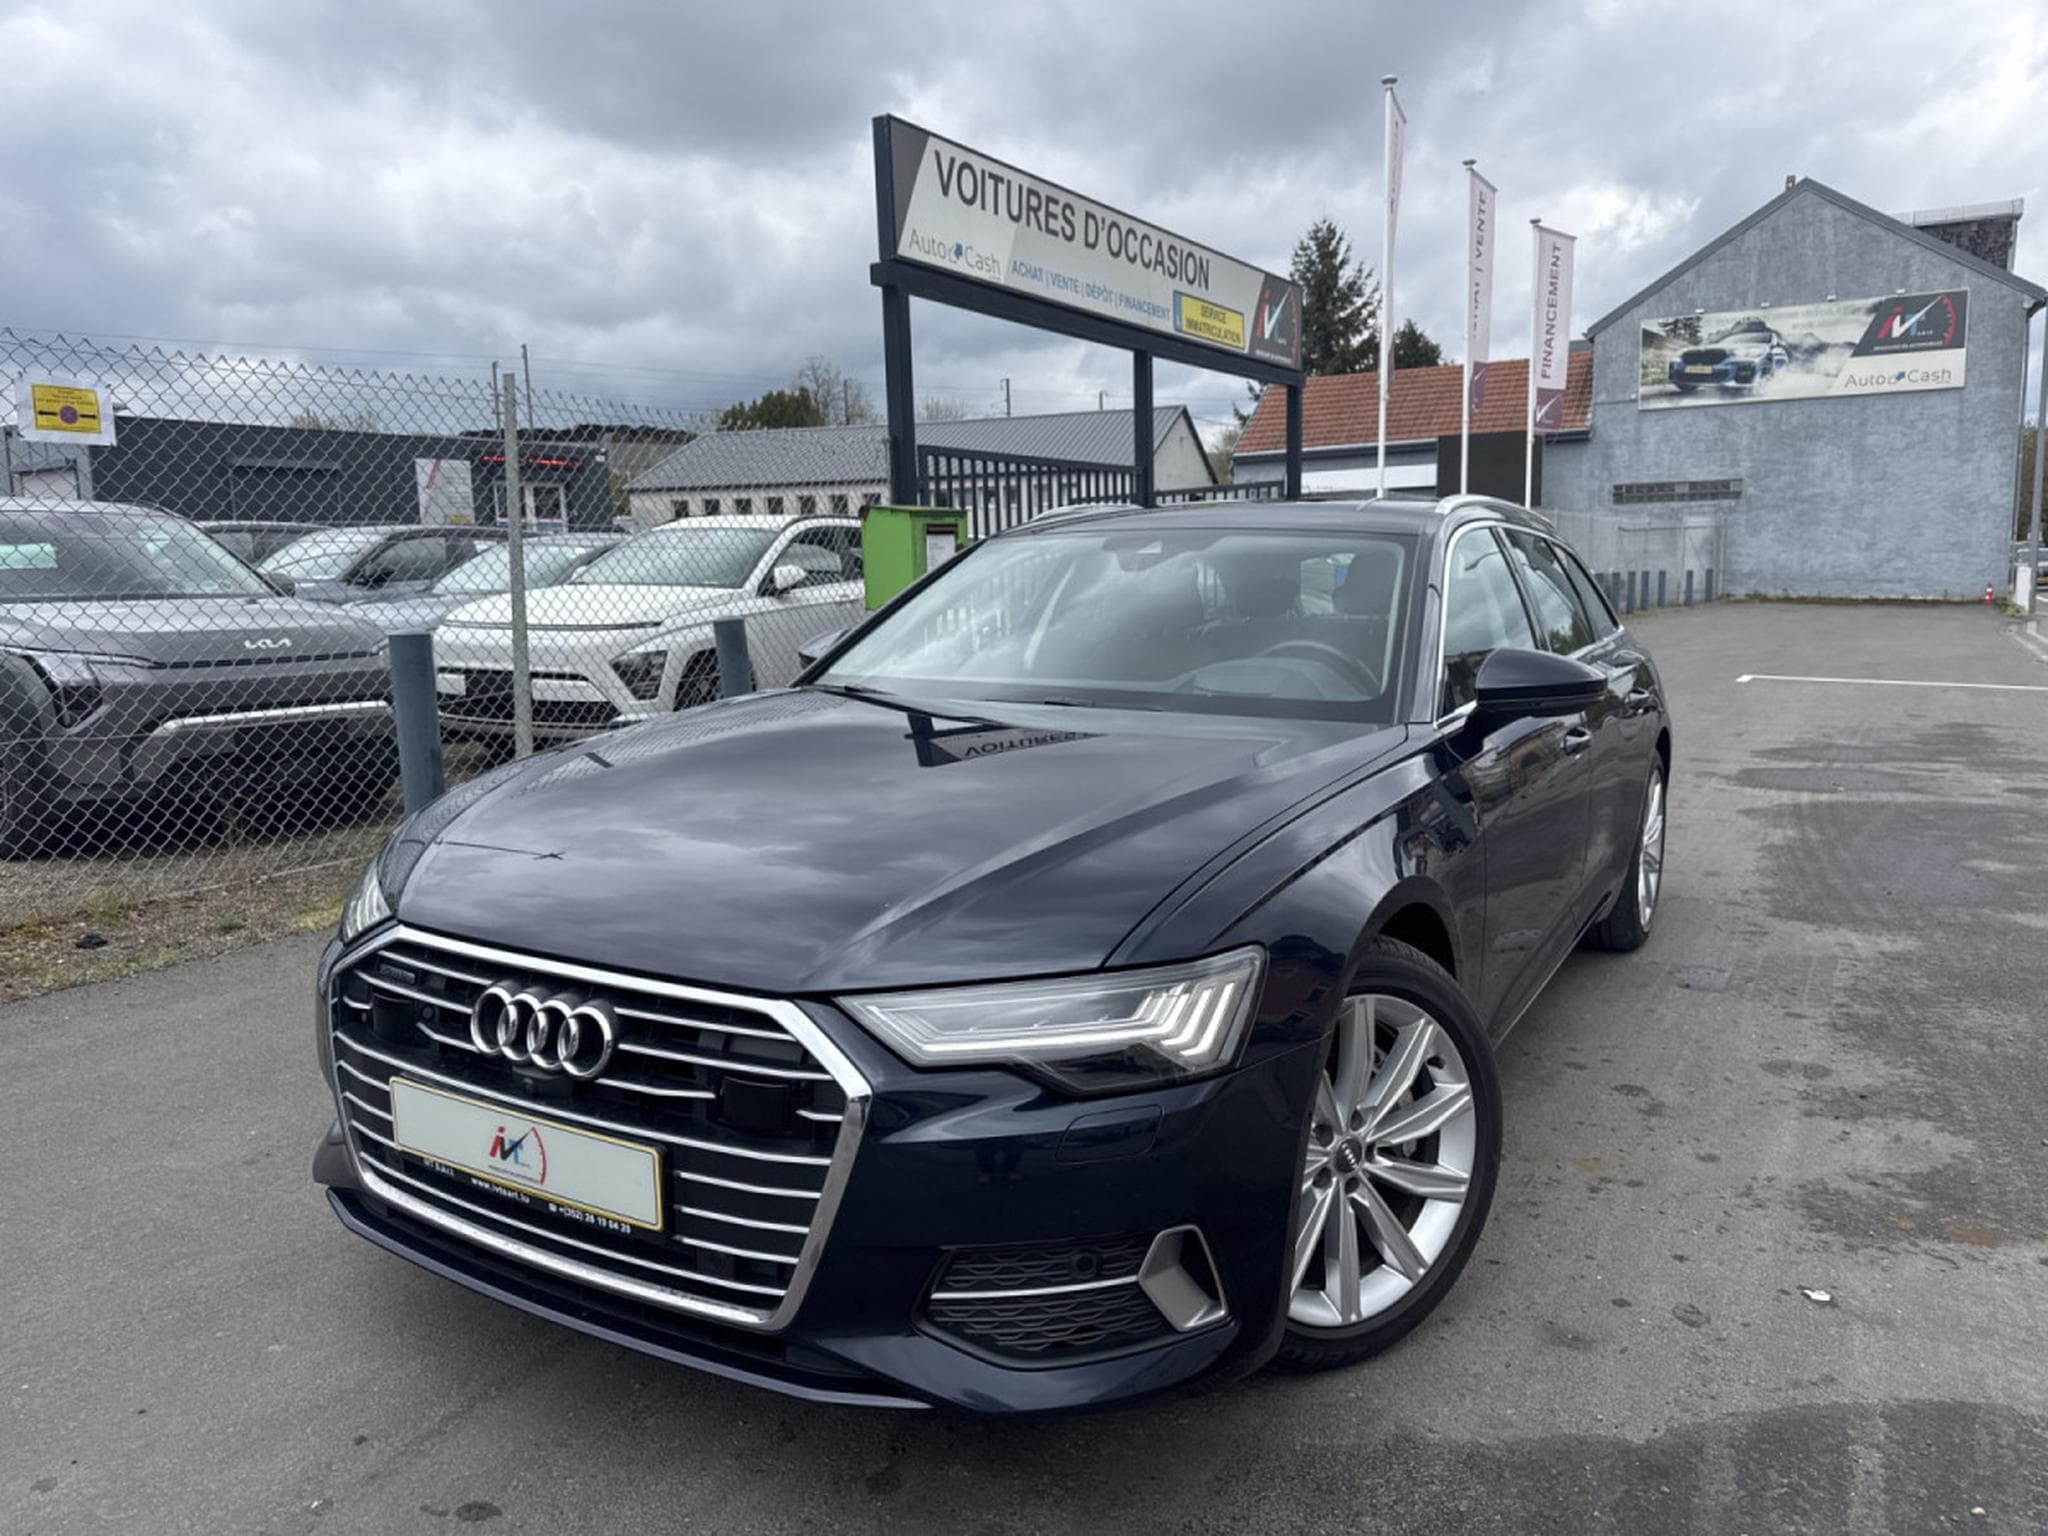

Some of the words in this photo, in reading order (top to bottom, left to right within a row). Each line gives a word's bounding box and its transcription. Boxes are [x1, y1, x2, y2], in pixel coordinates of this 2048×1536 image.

[934, 150, 1076, 242] VOITURES
[1085, 211, 1210, 291] D'OCCASION
[965, 245, 1001, 275] Cash
[1012, 260, 1044, 282] ACHAT
[1051, 273, 1080, 294] VENTE
[1119, 294, 1171, 321] FINANCEMENT
[1541, 242, 1562, 380] FINANCEMENT
[1907, 368, 1952, 383] Cash
